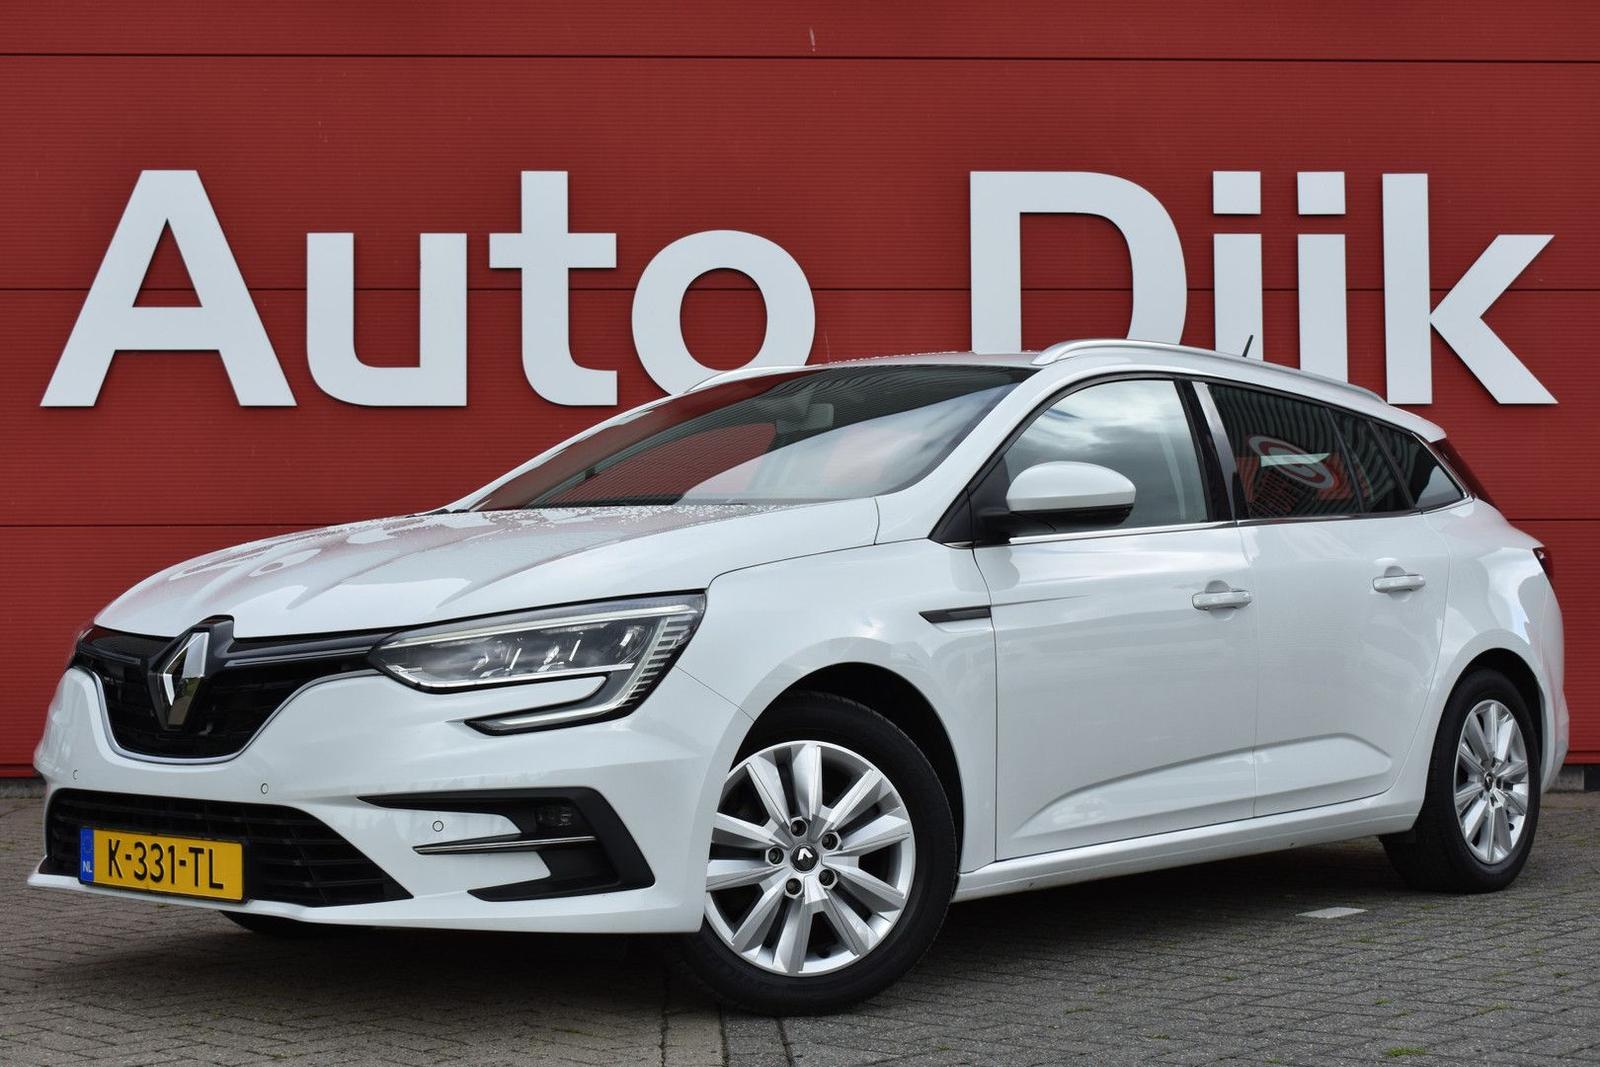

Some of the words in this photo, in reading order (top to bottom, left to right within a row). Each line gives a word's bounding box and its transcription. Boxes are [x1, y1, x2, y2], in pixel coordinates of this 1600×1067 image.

[40, 170, 816, 408] Auto
[969, 170, 1558, 405] Dijk
[82, 860, 93, 873] NL
[107, 838, 224, 890] K-331-TL
